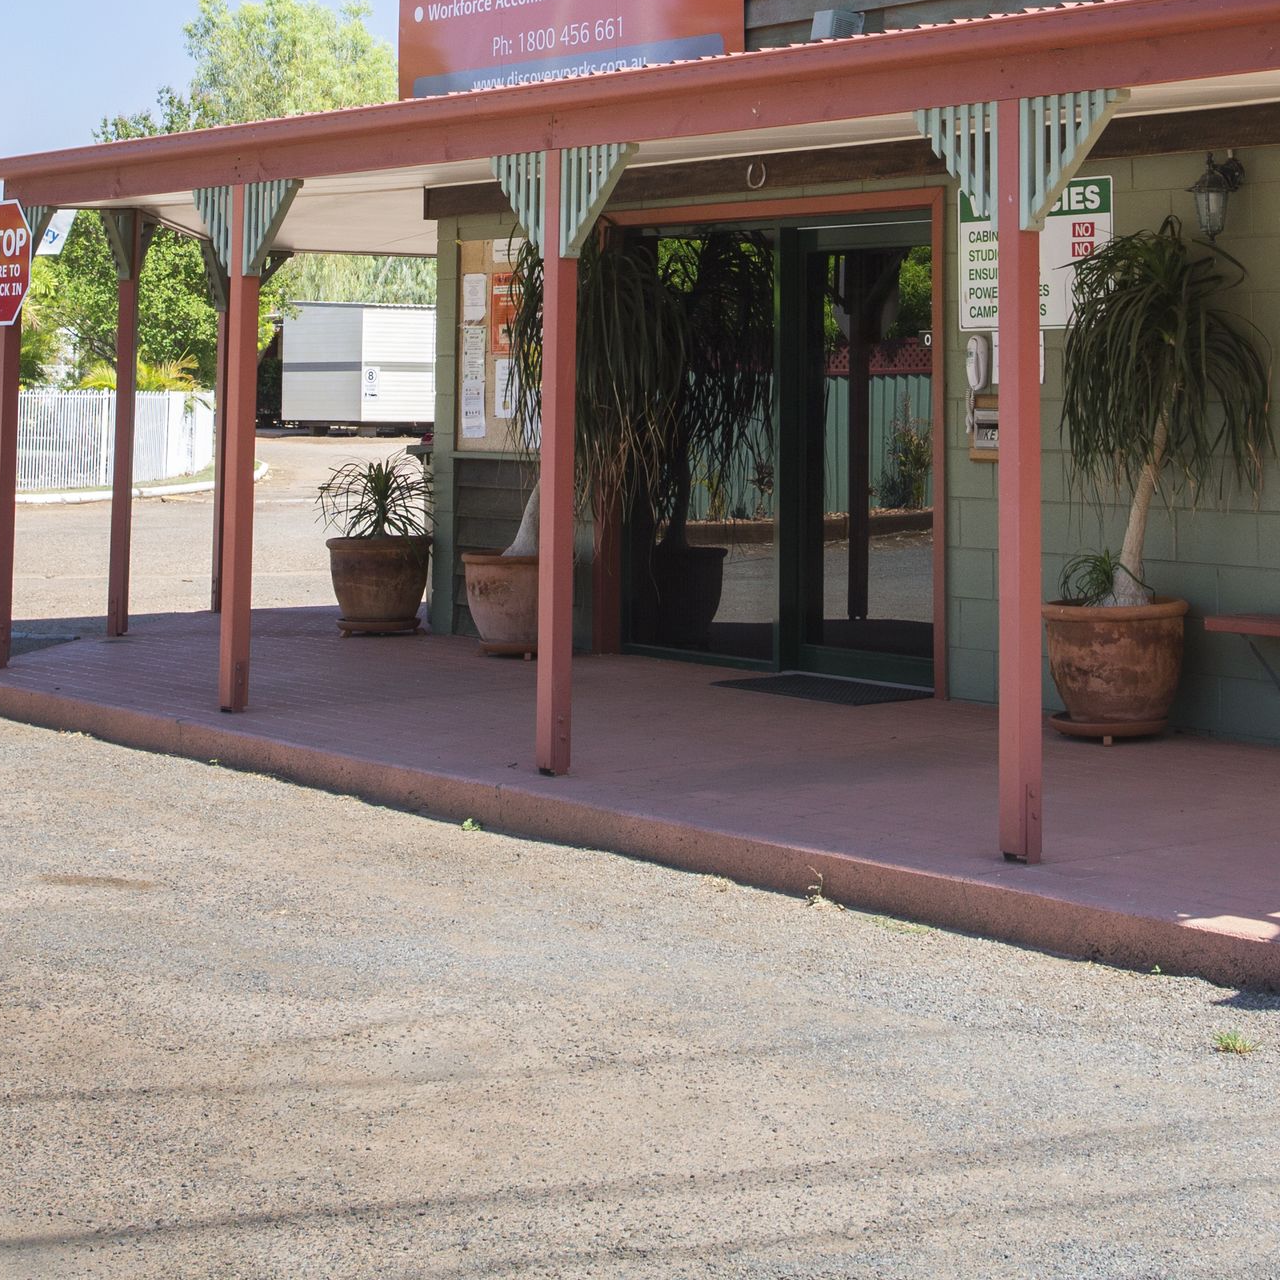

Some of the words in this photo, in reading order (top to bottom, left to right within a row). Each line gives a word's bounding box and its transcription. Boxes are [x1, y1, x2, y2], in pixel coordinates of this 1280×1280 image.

[493, 35, 513, 57] Ph:
[518, 27, 556, 53] 1800
[560, 22, 590, 46] 456
[594, 16, 623, 41] 661
[968, 230, 999, 244] CABIN
[1075, 223, 1092, 237] NO
[968, 249, 999, 262] STUDI
[1074, 242, 1091, 256] NO
[9, 264, 21, 278] TO
[968, 268, 998, 281] ENSUI
[12, 282, 22, 296] IN
[969, 286, 998, 299] POWE
[367, 371, 374, 381] 8
